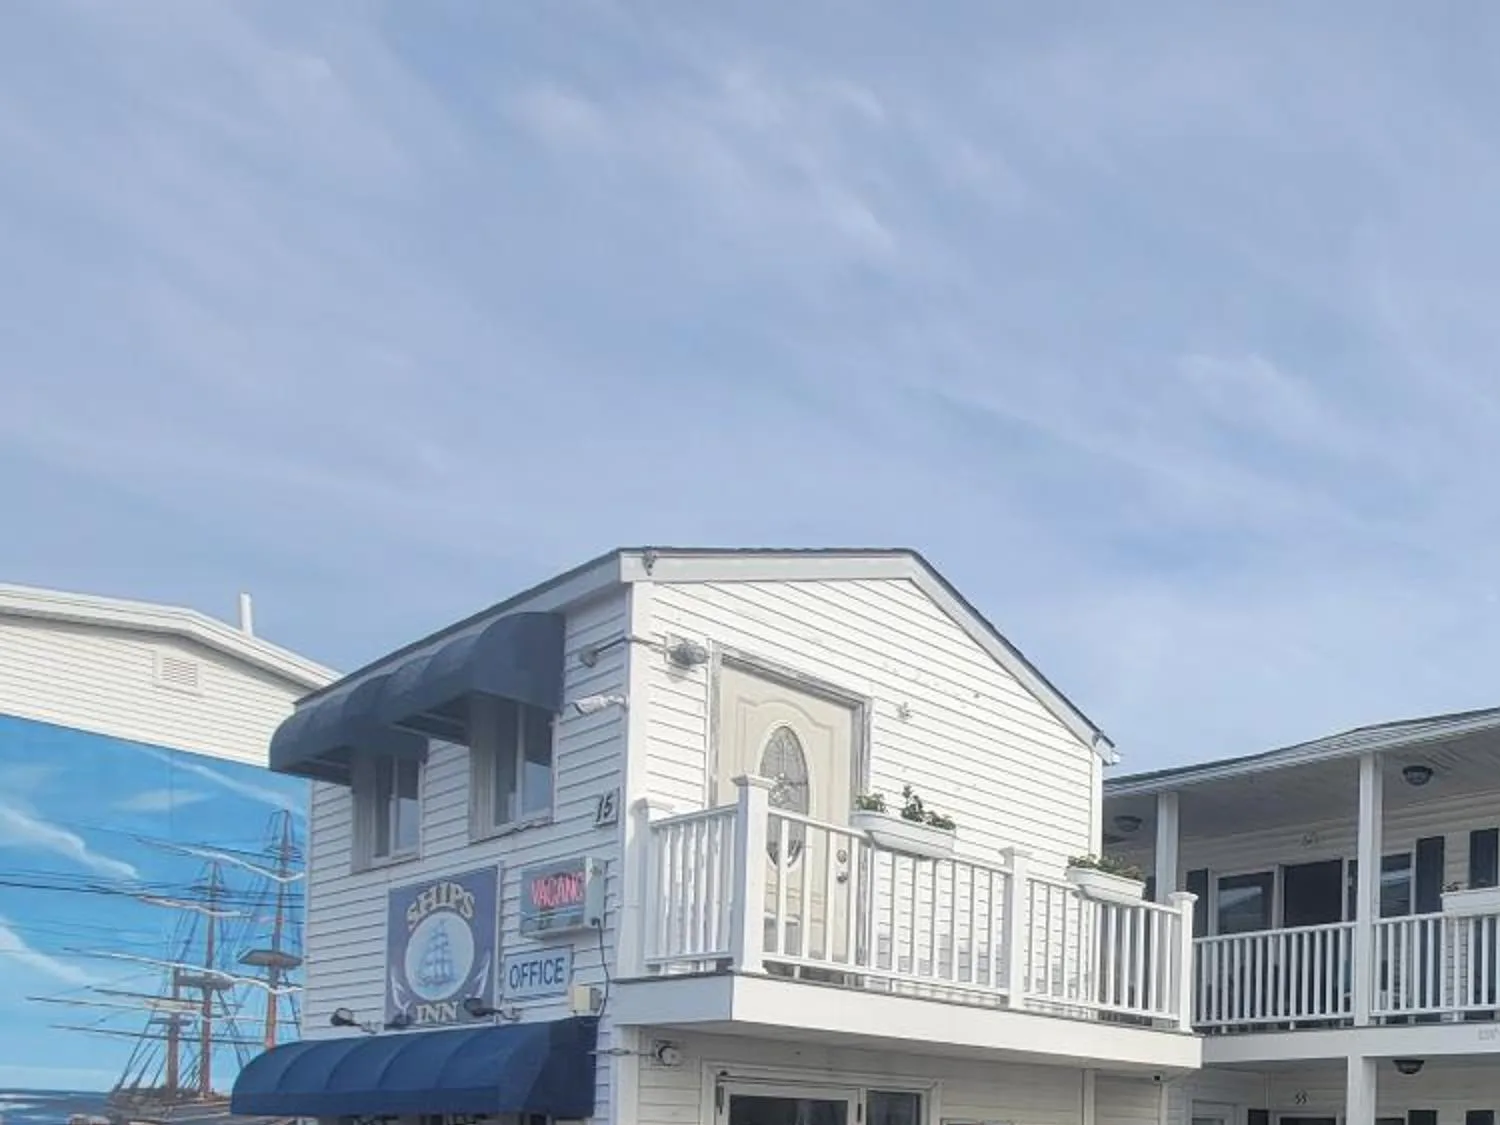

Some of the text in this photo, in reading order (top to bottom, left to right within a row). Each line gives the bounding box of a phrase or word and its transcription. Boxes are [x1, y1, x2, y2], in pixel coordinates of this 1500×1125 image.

[596, 794, 613, 822] 15
[531, 872, 584, 906] VACANC
[406, 881, 476, 932] SHIPS
[509, 957, 565, 989] OFFICE
[416, 1001, 459, 1025] INN
